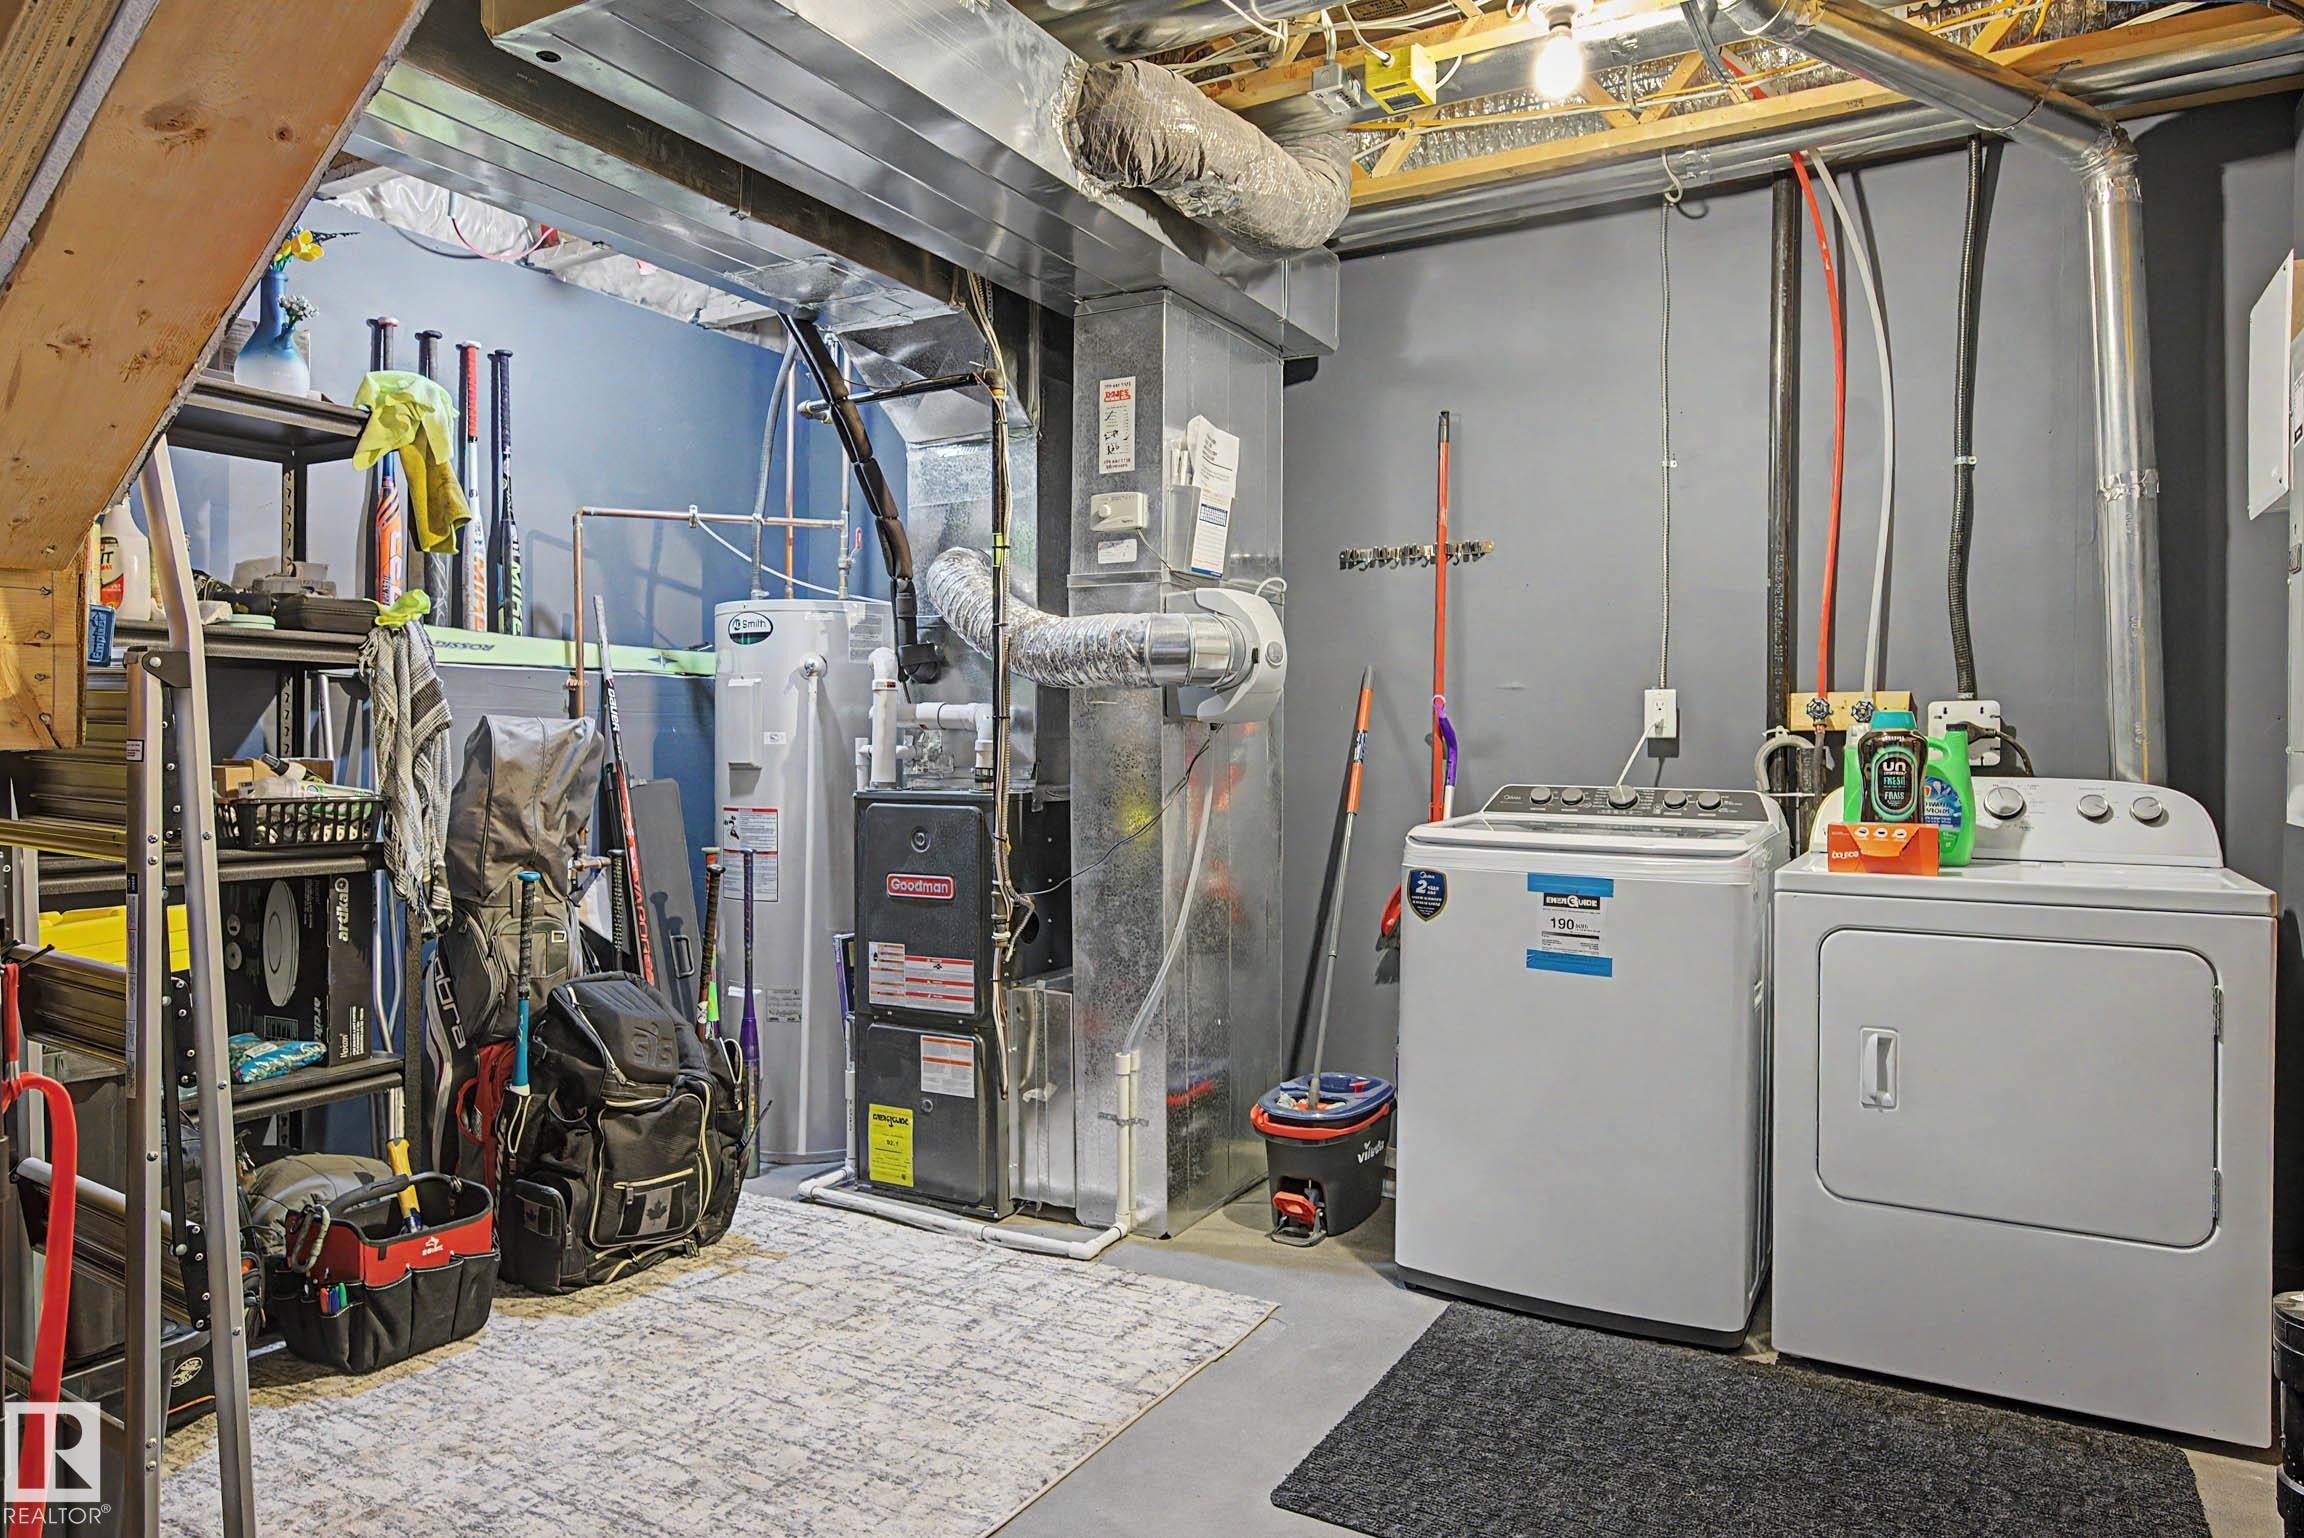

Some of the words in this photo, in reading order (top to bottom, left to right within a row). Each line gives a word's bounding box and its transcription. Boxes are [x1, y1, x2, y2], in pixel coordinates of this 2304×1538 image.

[742, 619, 767, 629] Smith
[890, 878, 949, 893] Goodman
[1415, 879, 1428, 894] 2
[1550, 918, 1575, 930] 190
